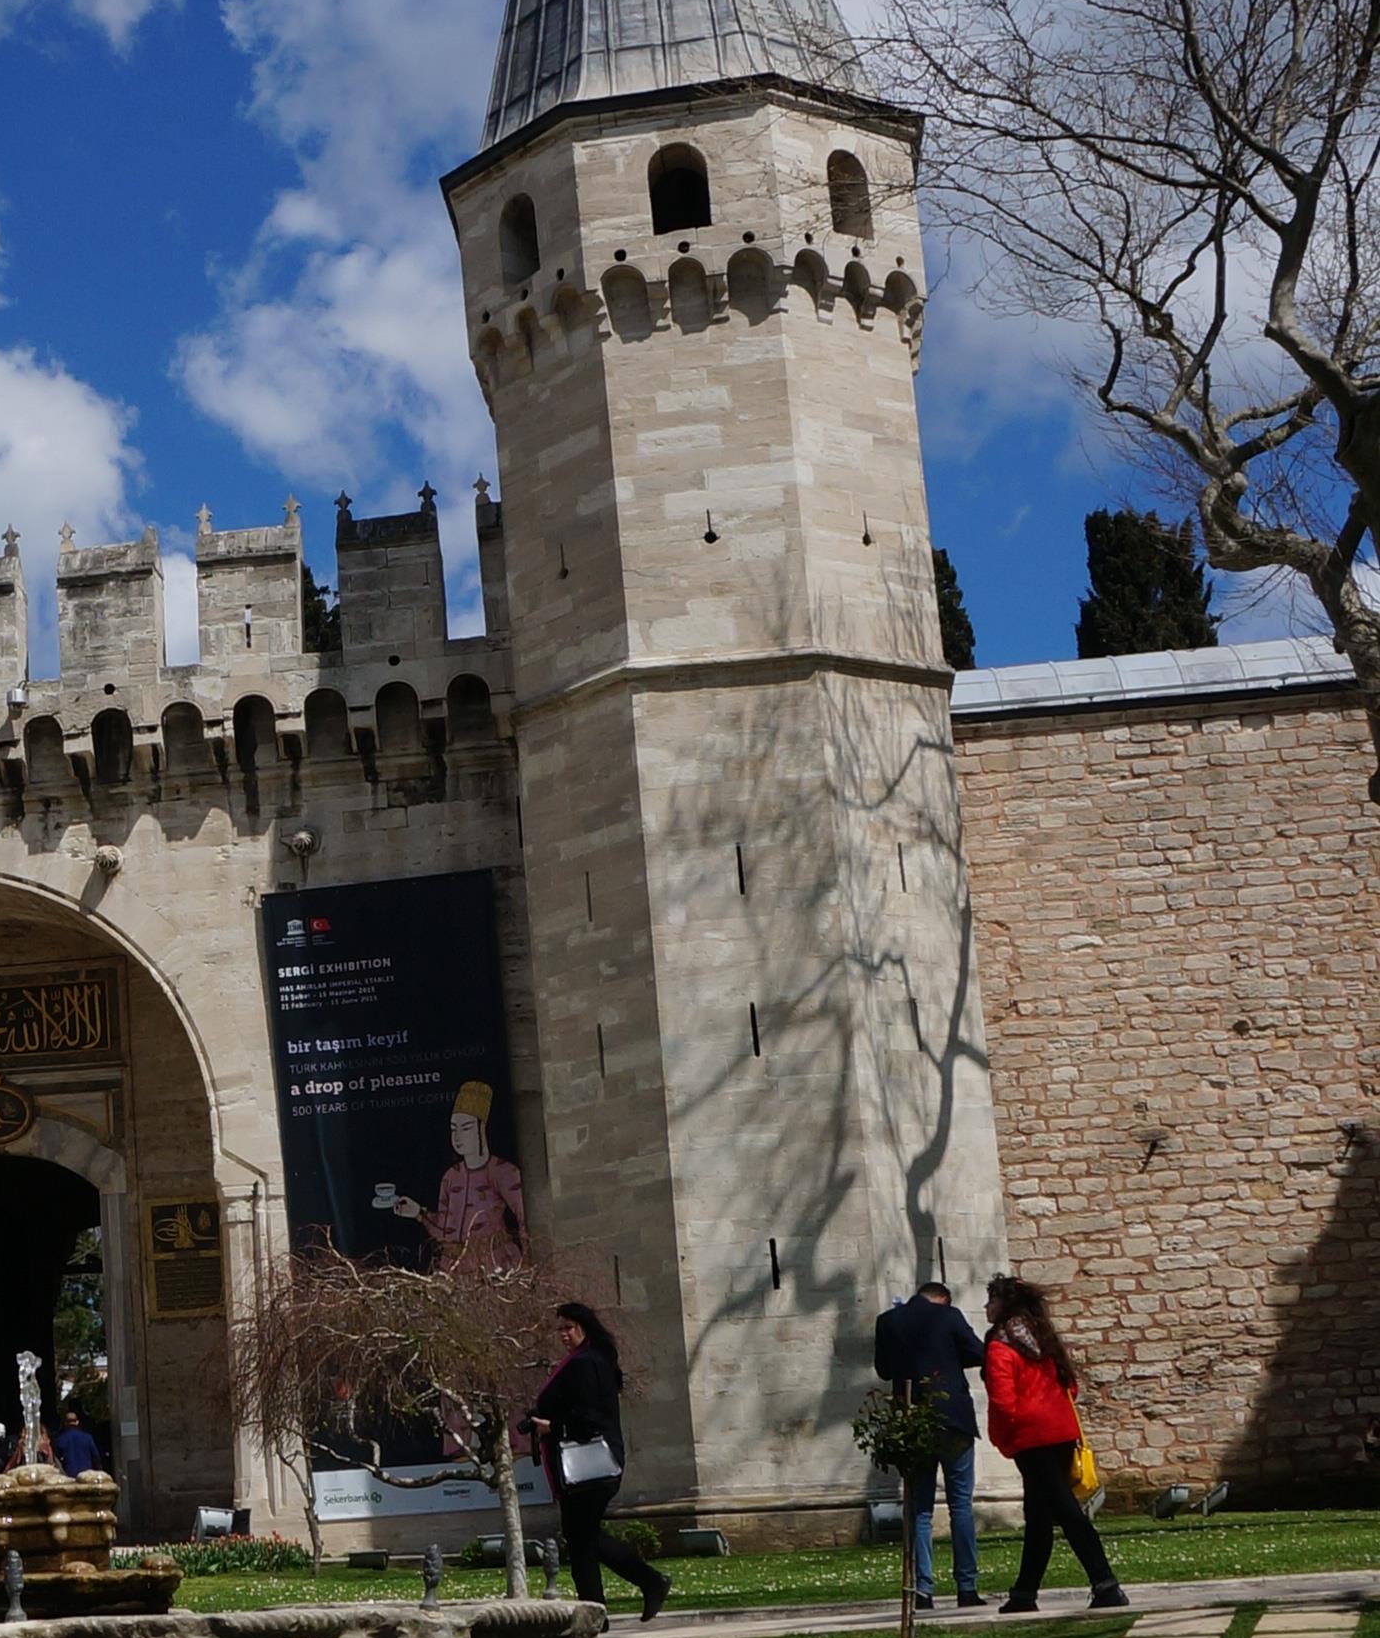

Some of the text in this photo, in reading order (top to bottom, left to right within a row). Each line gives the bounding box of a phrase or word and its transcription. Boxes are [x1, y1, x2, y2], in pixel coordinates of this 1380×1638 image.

[278, 958, 391, 978] SERGİ EXHIBITION
[287, 1030, 409, 1055] bir taşım keyif
[290, 1071, 441, 1096] a drop of pleasure
[292, 1106, 312, 1117] 500
[314, 1102, 348, 1114] YEARS
[323, 1491, 370, 1507] Şekerbank
